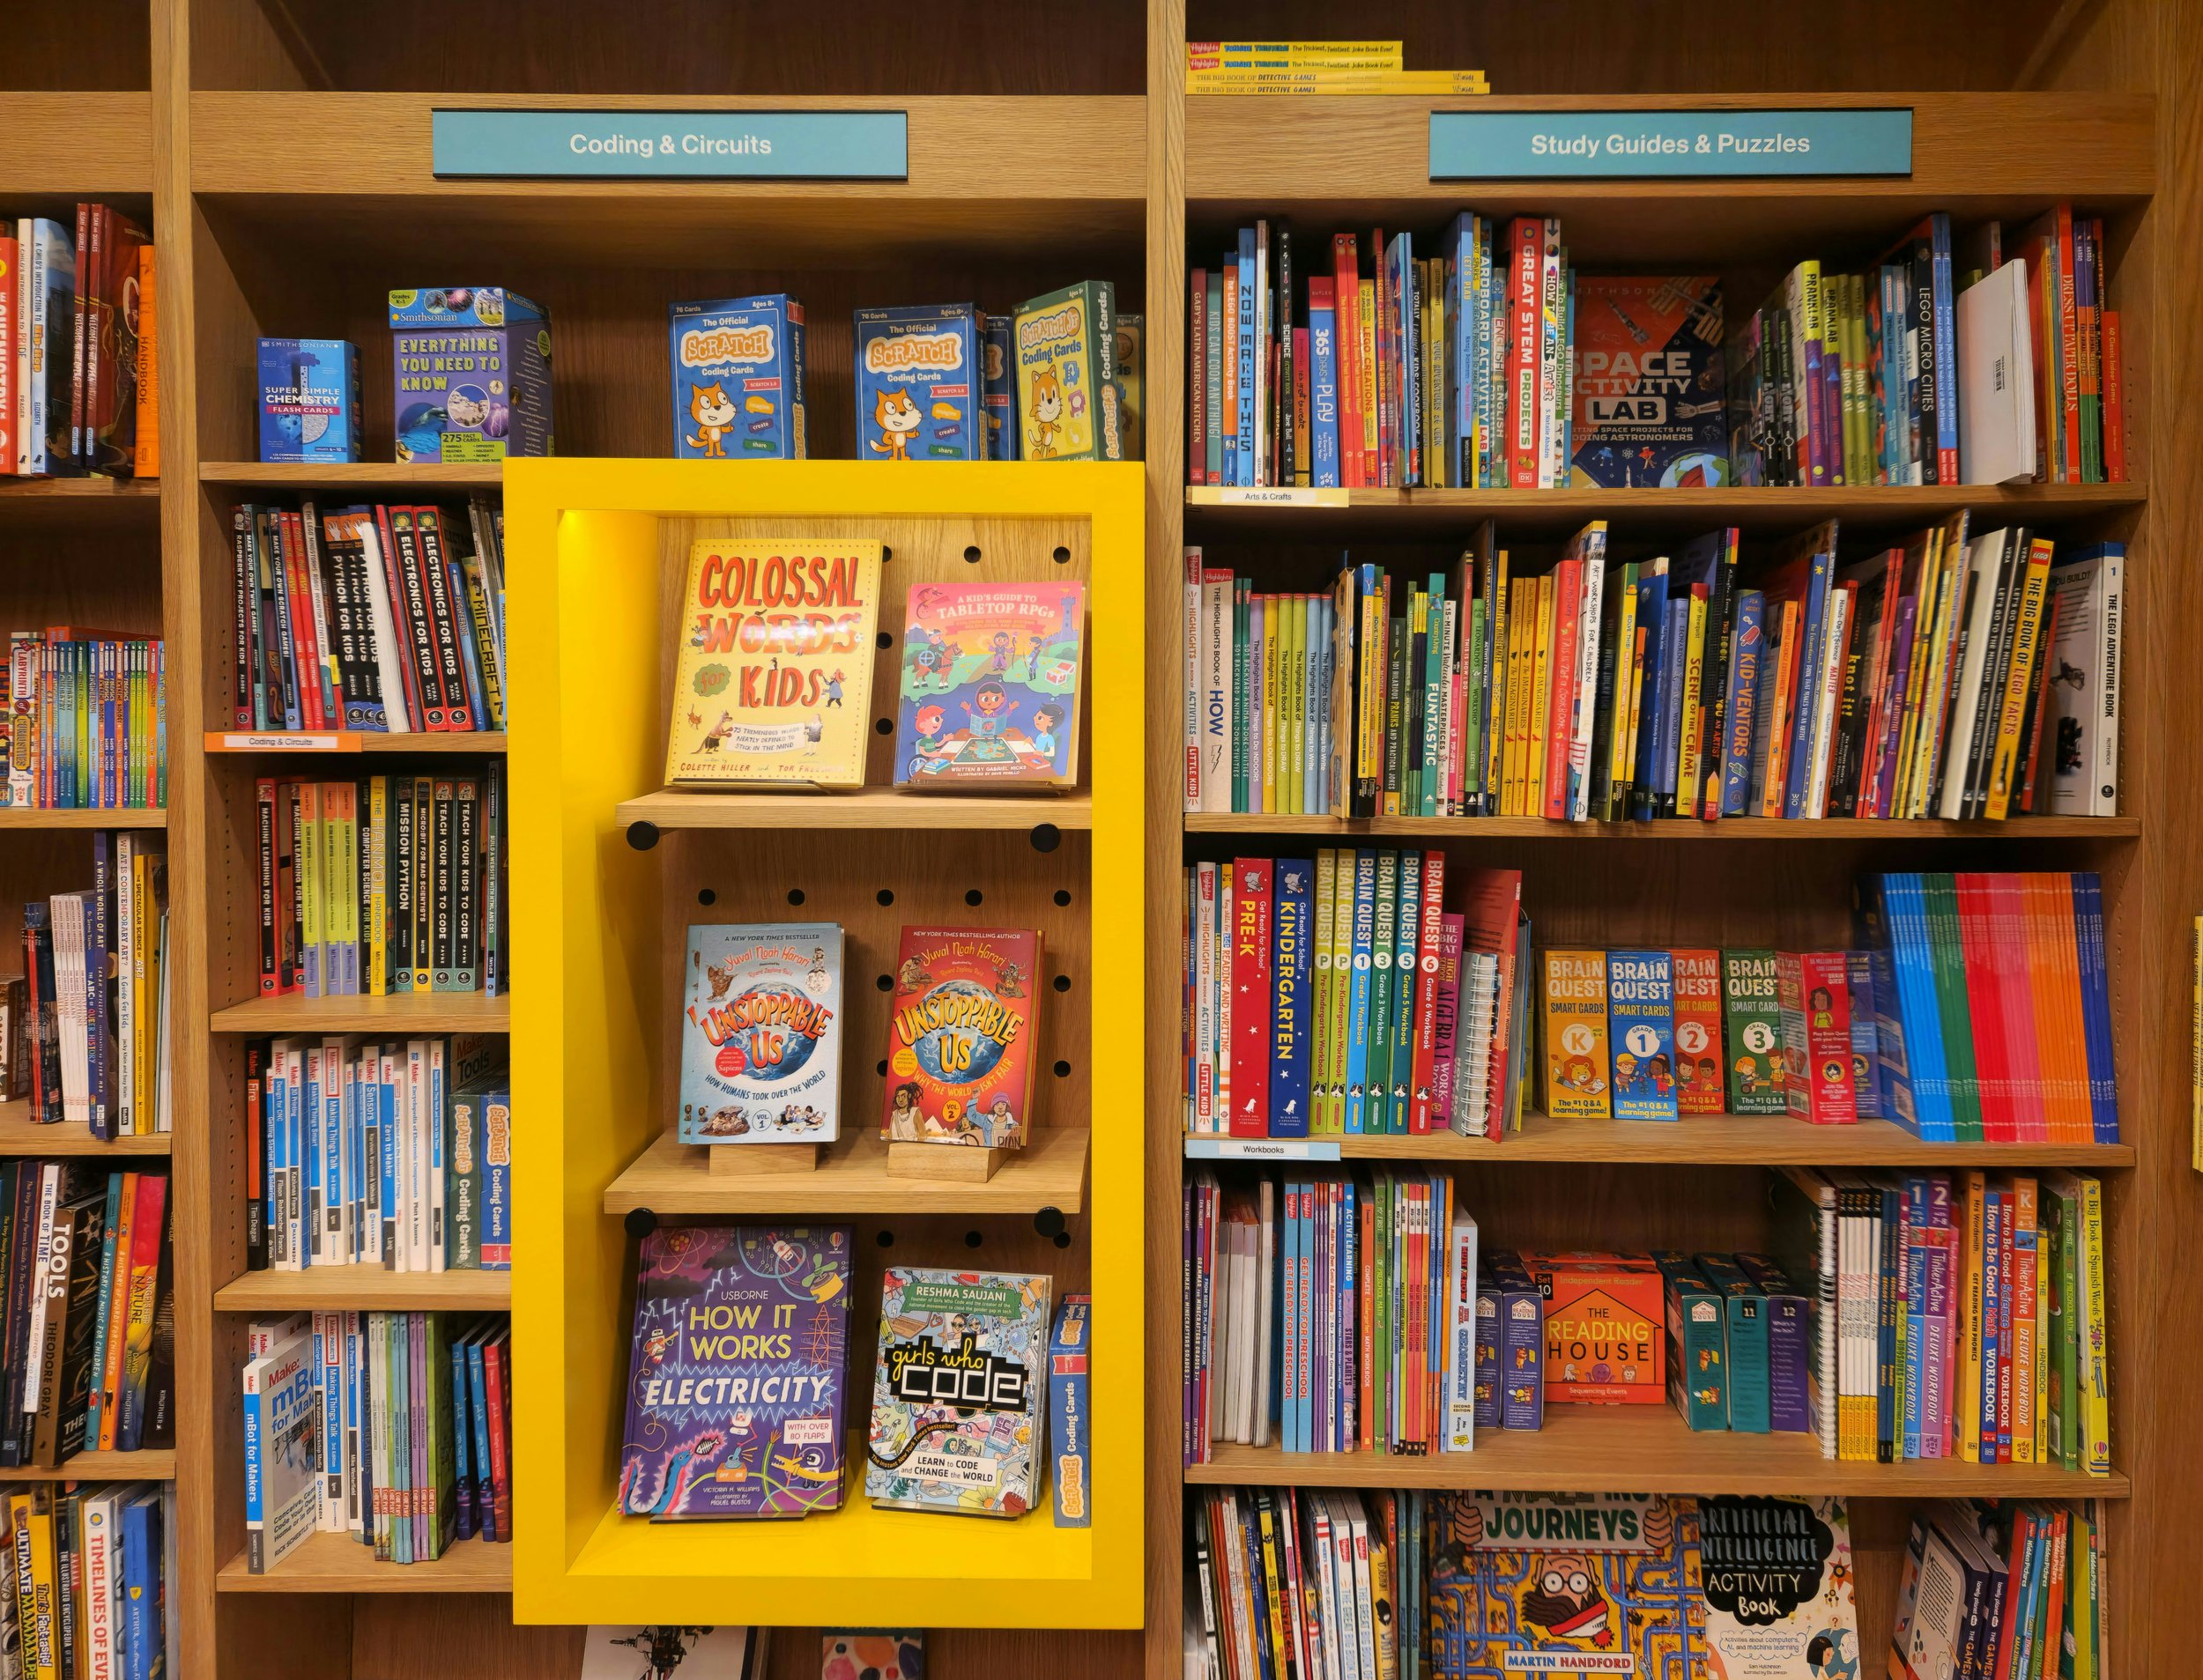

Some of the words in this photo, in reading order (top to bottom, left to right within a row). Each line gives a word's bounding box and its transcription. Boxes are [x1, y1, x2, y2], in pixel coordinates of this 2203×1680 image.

[570, 134, 654, 158] Coding
[659, 135, 676, 154] &
[682, 134, 772, 154] Circuits
[1532, 135, 1598, 158] Study
[1606, 133, 1689, 154] Guides
[1695, 133, 1711, 154] &
[1717, 133, 1810, 154] Puzzles
[1523, 246, 1534, 305] GREAT
[1806, 272, 1818, 329] PRANKLAB
[1919, 287, 1929, 324] LEGO
[400, 311, 456, 323] Smithsonian
[703, 317, 718, 326] The
[719, 317, 748, 326] Official
[400, 337, 498, 354] EVERYTHING
[686, 331, 768, 360] SCRATCH
[1522, 313, 1534, 364] STEM
[1920, 326, 1931, 369] MICRO
[138, 337, 147, 405] HANDBOOK
[400, 357, 427, 372] YOU
[432, 357, 471, 372] NEED
[474, 357, 500, 370] TO
[701, 368, 728, 378] Coding
[730, 366, 754, 375] Cards
[265, 386, 298, 395] SUPER
[401, 374, 447, 391] KNOW
[1921, 374, 1933, 412] CITIES
[265, 395, 339, 405] CHEMISTRY
[1520, 374, 1532, 446] PROJECTS
[1592, 403, 1660, 420] LAB
[442, 433, 462, 442] 275
[401, 536, 422, 617] ELECTRONICS
[698, 554, 863, 608] COLOSSAL
[938, 603, 1014, 619] TABLETOP
[1019, 603, 1055, 618] RPGs
[2108, 594, 2118, 611] THE
[415, 621, 427, 644] FOR
[696, 612, 861, 654] WORDS
[2107, 612, 2117, 634] LEGO
[420, 648, 433, 676] KIDS
[2105, 636, 2116, 690] ADVENTURE
[700, 670, 724, 695] for
[738, 668, 824, 709] KIDS
[1213, 674, 1220, 686] OF
[1688, 658, 1701, 701] SCENE
[1209, 690, 1223, 736] HOW
[1691, 704, 1696, 714] OF
[1733, 653, 1755, 757] KID-VENTORS
[2104, 691, 2114, 718] BOOK
[1424, 683, 1437, 766] FUNTASTIC
[248, 737, 275, 746] Coding
[285, 737, 313, 746] Circuits
[680, 762, 716, 772] COLETTE
[1683, 734, 1695, 778] CRIME
[400, 803, 409, 855] MISSION
[399, 860, 409, 910] PYTHON
[440, 896, 446, 909] TO
[97, 924, 104, 933] OF
[1240, 900, 1255, 956] PRE-K
[1278, 902, 1295, 1060] KINDERGARTEN
[701, 994, 833, 1047] UNSTOPPABLE
[894, 993, 1024, 1047] UNSTOPPABLE
[752, 1031, 783, 1068] US
[939, 1033, 971, 1073] US
[705, 1074, 722, 1087] HOW
[722, 1084, 750, 1101] HUMANS
[752, 1092, 770, 1101] TOOK
[771, 1087, 788, 1099] OVER
[789, 1084, 804, 1096] THE
[802, 1069, 827, 1092] WORLD
[759, 1121, 764, 1129] 1
[947, 1110, 955, 1121] 2
[1987, 1203, 1999, 1230] How
[1987, 1232, 1997, 1243] to
[48, 1224, 71, 1299] TOOLS
[1986, 1246, 1998, 1262] Be
[1538, 1275, 1551, 1284] Set
[1539, 1285, 1552, 1294] 10
[1986, 1265, 1998, 1298] Good
[721, 1290, 768, 1300] USBORNE
[916, 1287, 959, 1299] RESHMA
[961, 1291, 1006, 1301] SAUJANI
[690, 1306, 762, 1329] HOW
[774, 1305, 796, 1328] IT
[1588, 1308, 1609, 1319] THE
[1985, 1307, 1997, 1338] Math
[1548, 1321, 1649, 1342] READING
[45, 1321, 56, 1387] THEODORE
[691, 1336, 790, 1360] WORKS
[893, 1340, 935, 1381] girls
[940, 1337, 983, 1369] who
[1548, 1342, 1649, 1361] HOUSE
[644, 1376, 831, 1405] ELECTRICITY
[901, 1358, 1020, 1403] code
[1984, 1348, 1996, 1423] WORKBOOK
[41, 1388, 51, 1419] GRAY
[1066, 1381, 1077, 1415] Cards
[247, 1413, 257, 1443] mBot
[810, 1422, 829, 1431] OVER
[1066, 1415, 1079, 1452] Coding
[248, 1446, 257, 1462] for
[917, 1457, 944, 1467] LEARN
[956, 1460, 978, 1469] CODE
[248, 1463, 258, 1503] Makers
[901, 1466, 912, 1475] and
[914, 1467, 948, 1477] CHANGE
[951, 1470, 961, 1479] the
[962, 1471, 993, 1482] WORLD
[1487, 1509, 1639, 1541] JOURNEYS
[1709, 1573, 1800, 1593] ACTIVITY
[1509, 1655, 1557, 1669] MARTIN
[1560, 1656, 1630, 1669] HANDFORD
